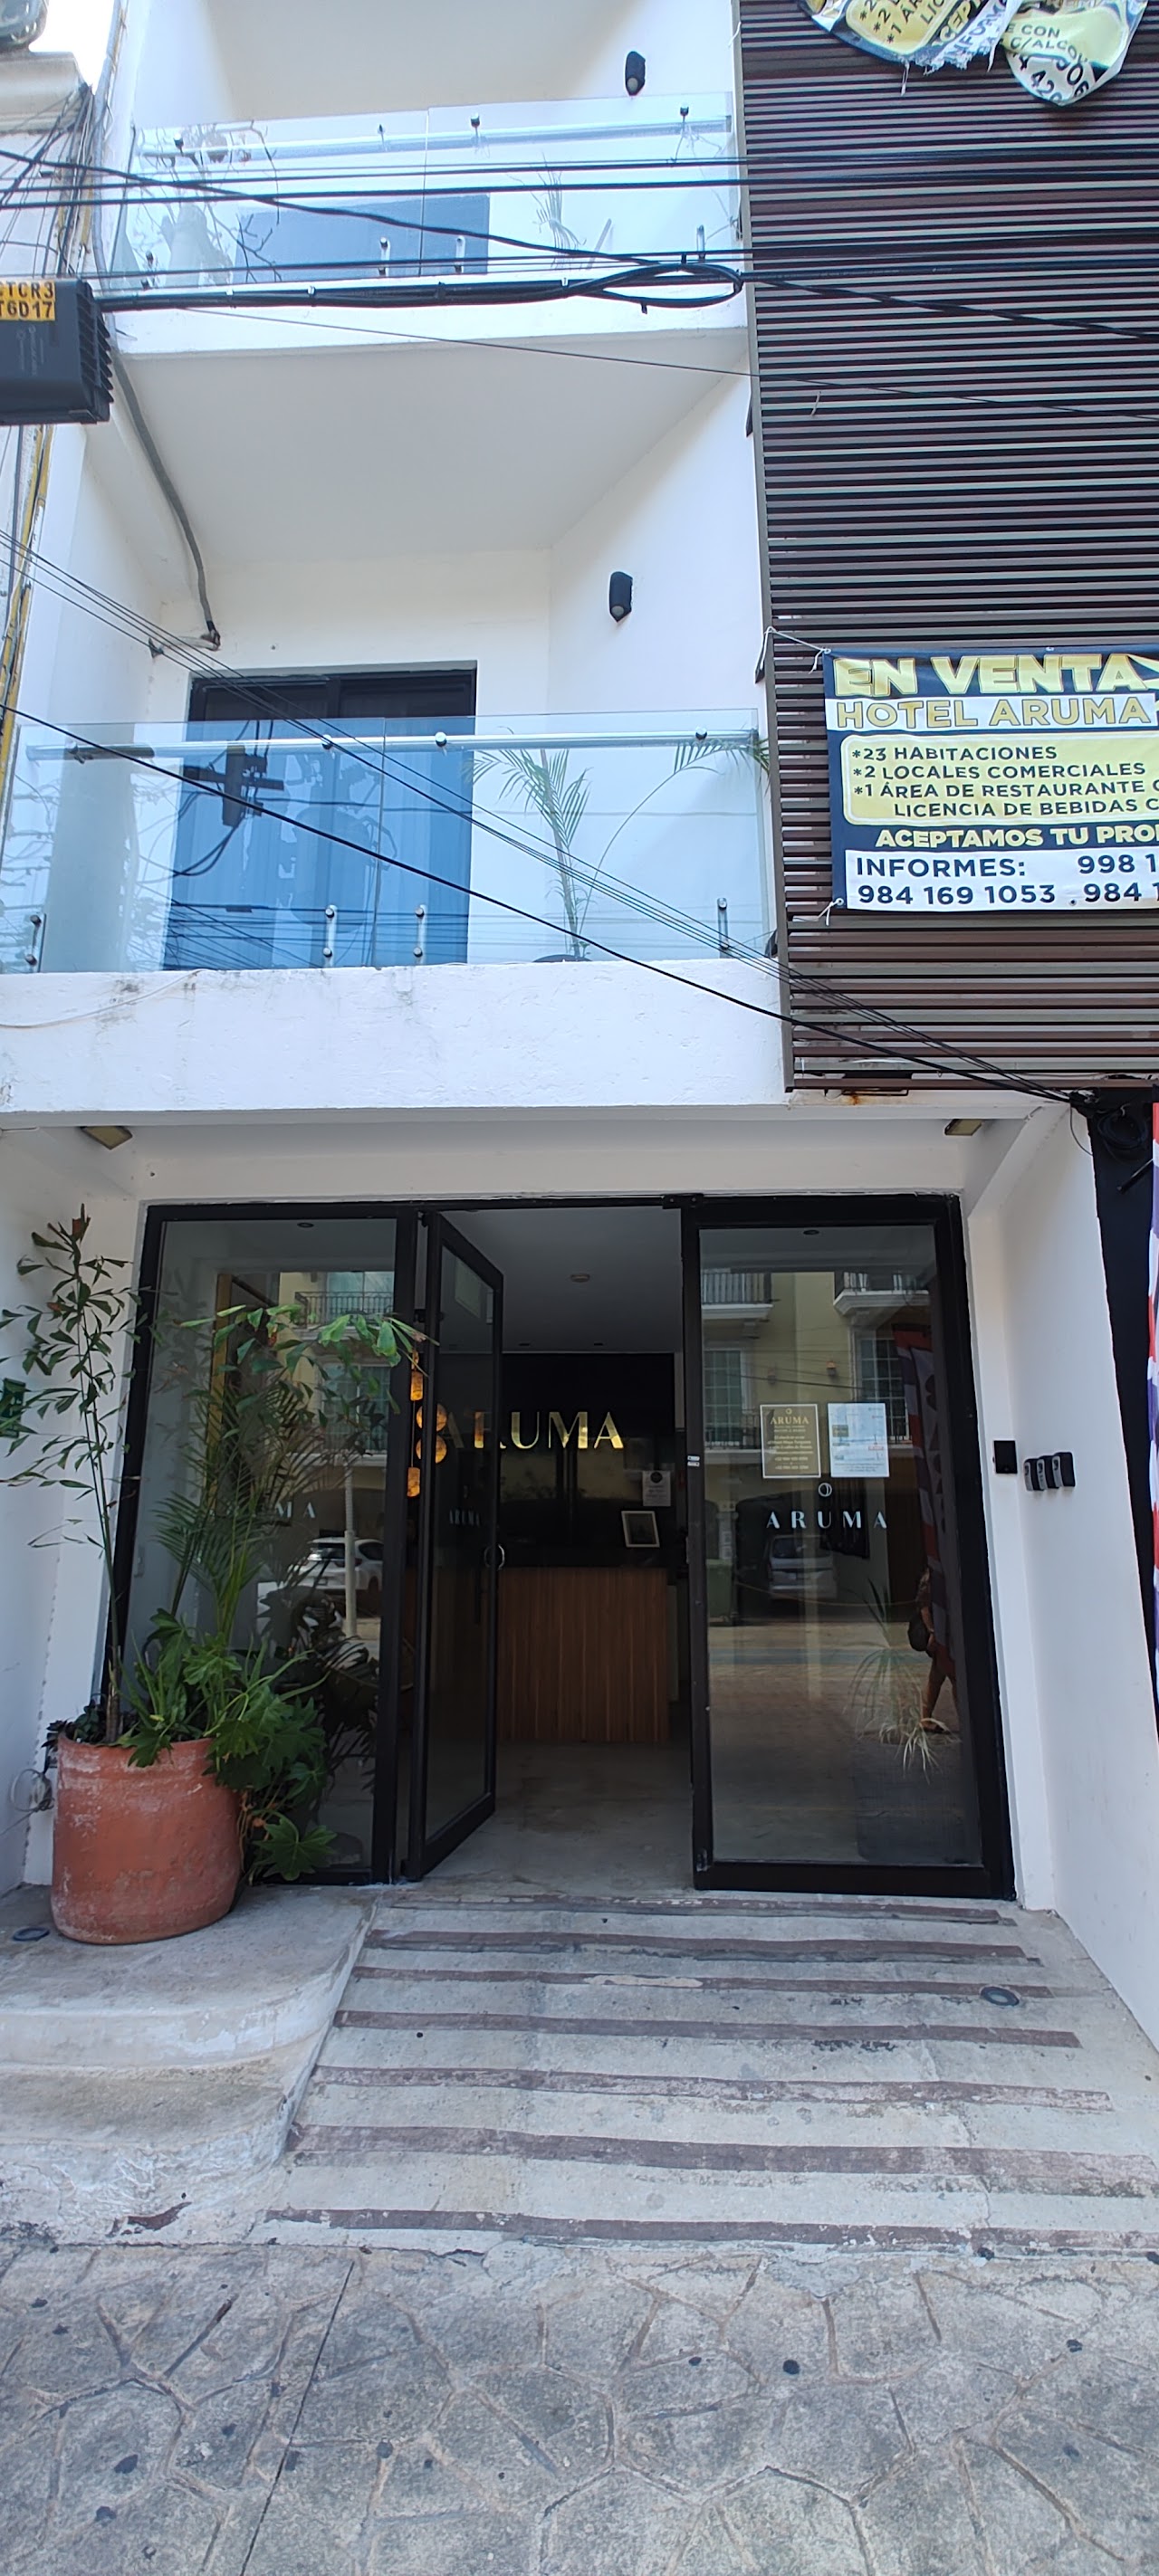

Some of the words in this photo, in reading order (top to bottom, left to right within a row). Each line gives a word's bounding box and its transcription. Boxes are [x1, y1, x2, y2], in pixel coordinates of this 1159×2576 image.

[1020, 24, 1060, 39] CON
[834, 658, 918, 696] EN
[931, 654, 1149, 694] VENTA
[837, 700, 979, 729] HOTEL
[989, 697, 1152, 727] ARUMA
[894, 746, 1058, 761] HABITACIONES
[883, 766, 980, 780] LOCALES
[987, 762, 1145, 779] COMERCIALES
[880, 782, 939, 798] ÁREA
[946, 785, 974, 798] DE
[982, 780, 1145, 797] RESTAURANTE
[895, 803, 995, 817] LICENCIA
[1003, 803, 1032, 816] DE
[1039, 798, 1138, 816] BEBIDAS
[875, 828, 1044, 848] ACEPTAMOS
[1050, 826, 1089, 845] TU
[1096, 824, 1159, 844] PRO
[857, 857, 1025, 878] INFORMES:
[1078, 854, 1135, 874] 998
[857, 885, 914, 905] 984
[924, 886, 974, 905] 169
[984, 884, 1056, 905] 1053
[1083, 882, 1143, 902] 984
[770, 1416, 809, 1426] ARUMA
[766, 1511, 887, 1530] ARUMA
